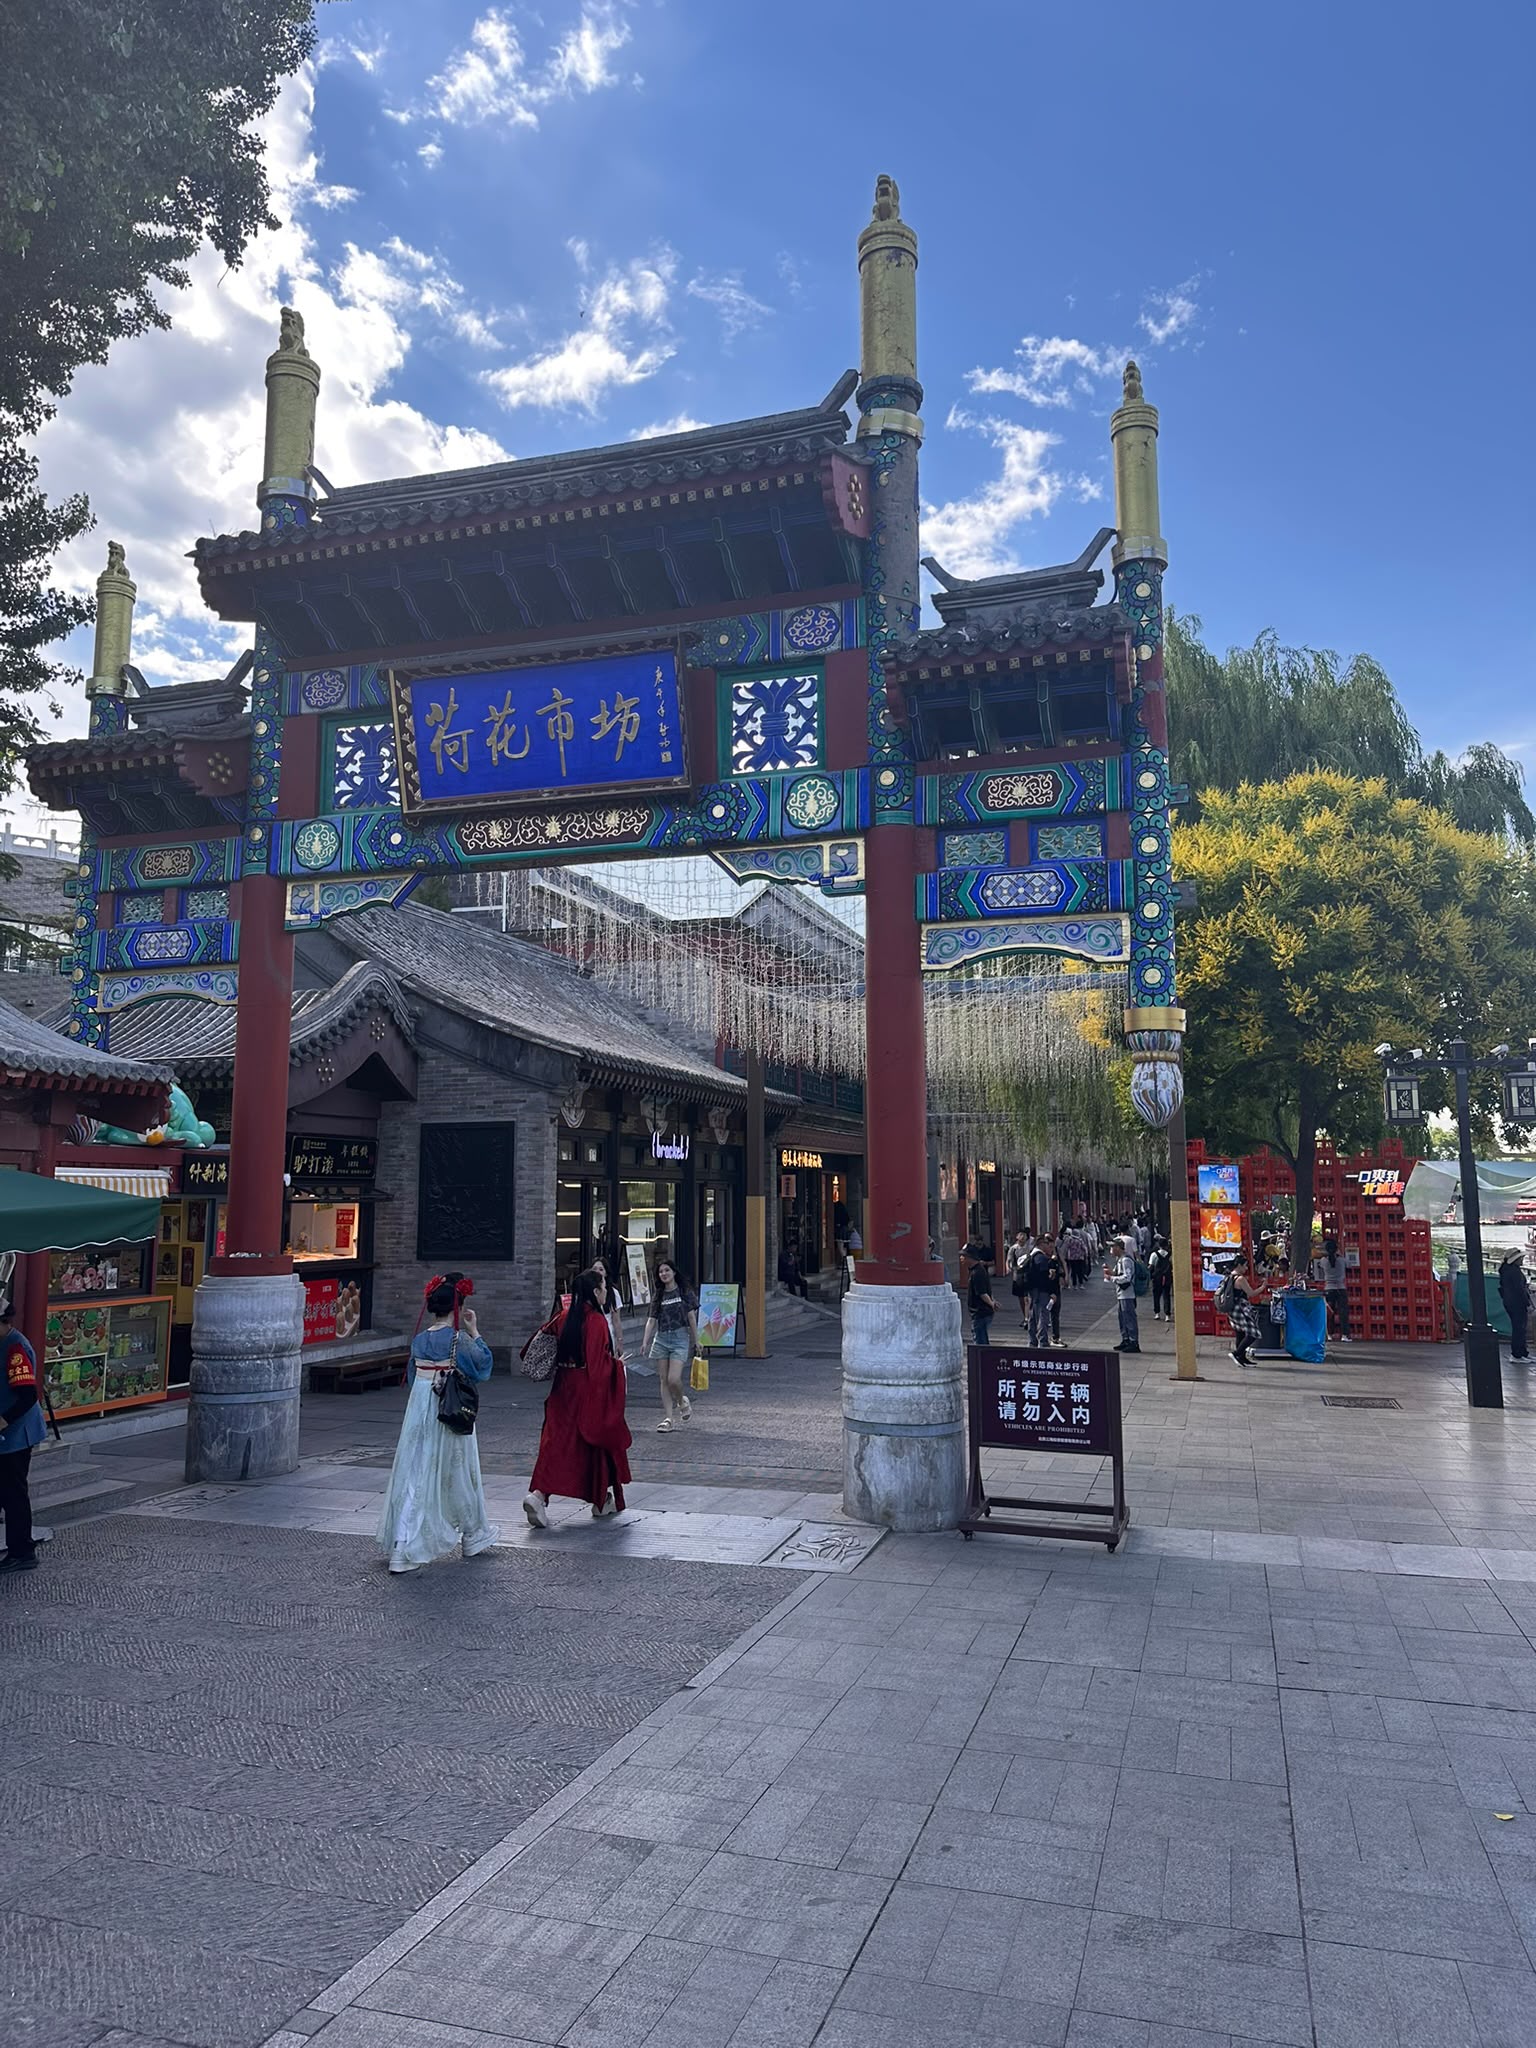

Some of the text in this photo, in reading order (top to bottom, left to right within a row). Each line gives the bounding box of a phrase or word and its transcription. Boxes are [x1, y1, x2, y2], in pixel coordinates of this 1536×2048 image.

[1345, 1169, 1399, 1182] 一口爽到
[998, 1379, 1090, 1403] 所有车辆
[998, 1401, 1090, 1425] 请勿入内
[1047, 1426, 1085, 1434] PROHIBITED
